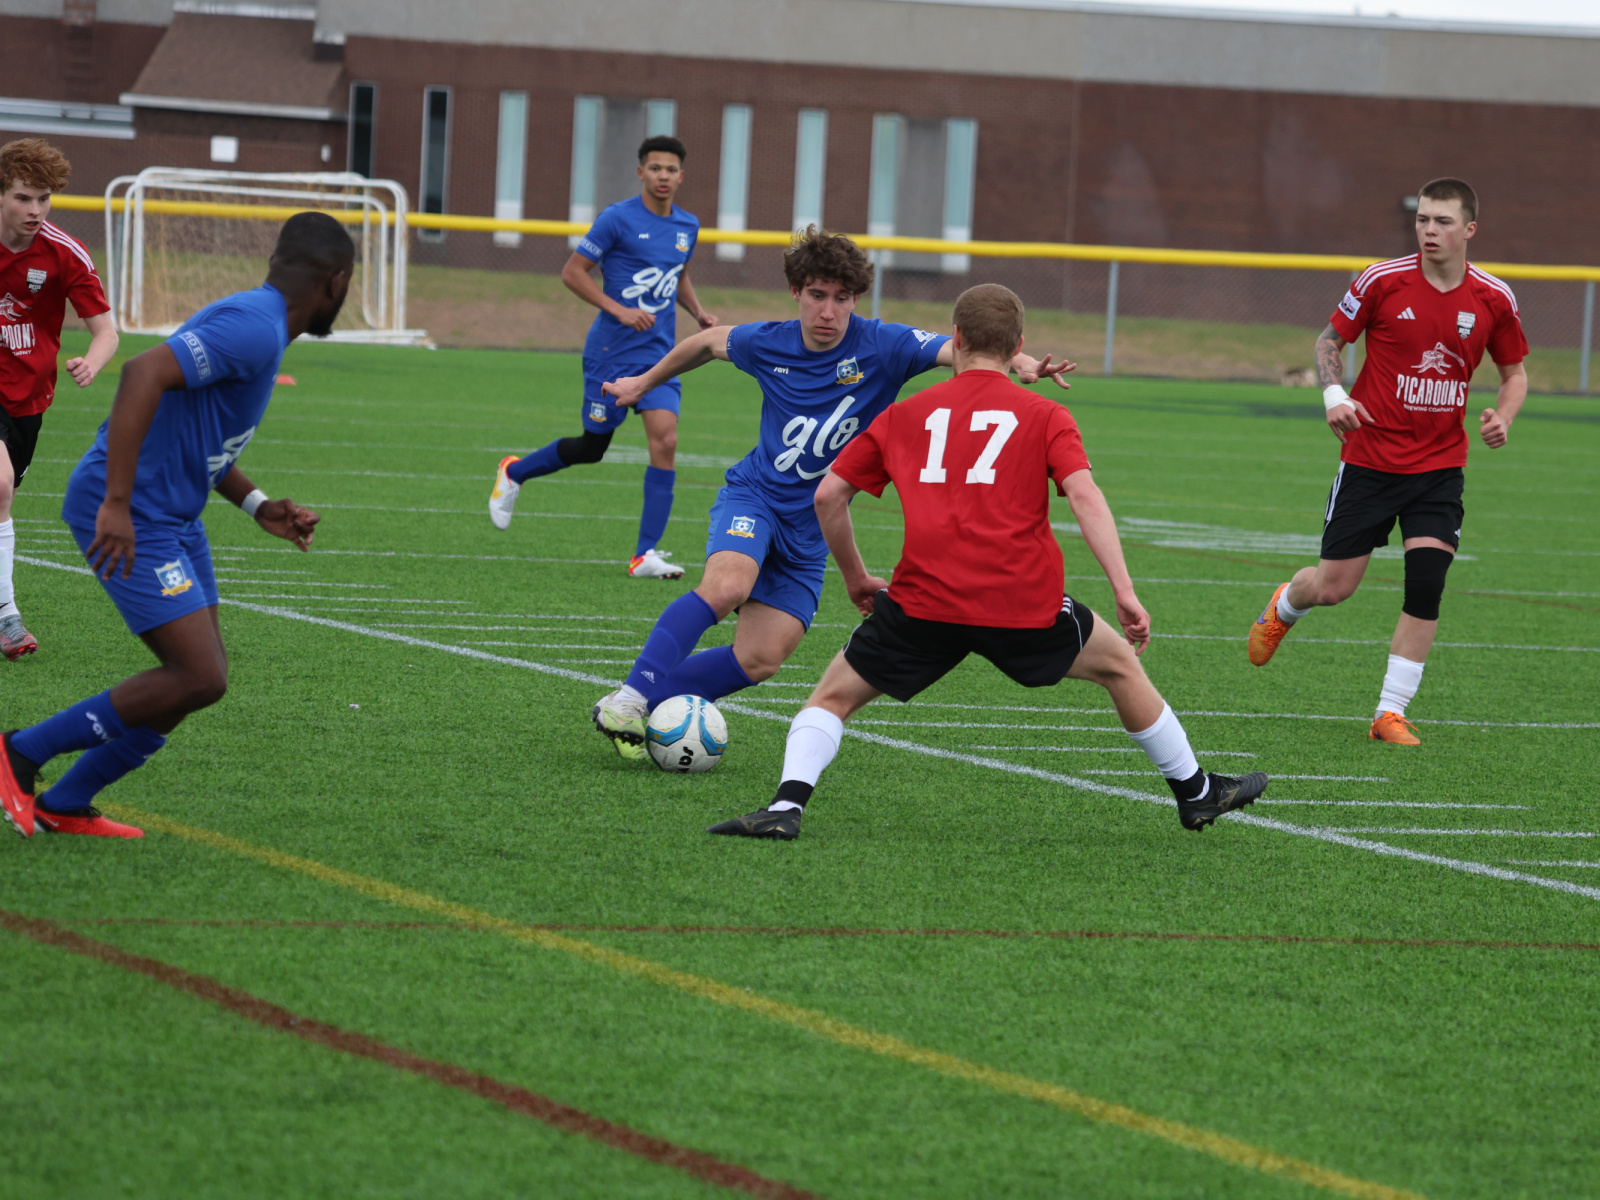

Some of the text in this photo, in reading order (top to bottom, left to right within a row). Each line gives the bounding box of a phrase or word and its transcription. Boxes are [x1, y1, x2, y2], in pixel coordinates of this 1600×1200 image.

[621, 263, 684, 300] glo
[1396, 373, 1467, 407] PICAROONS
[774, 395, 860, 473] glo
[919, 407, 1019, 485] 17
